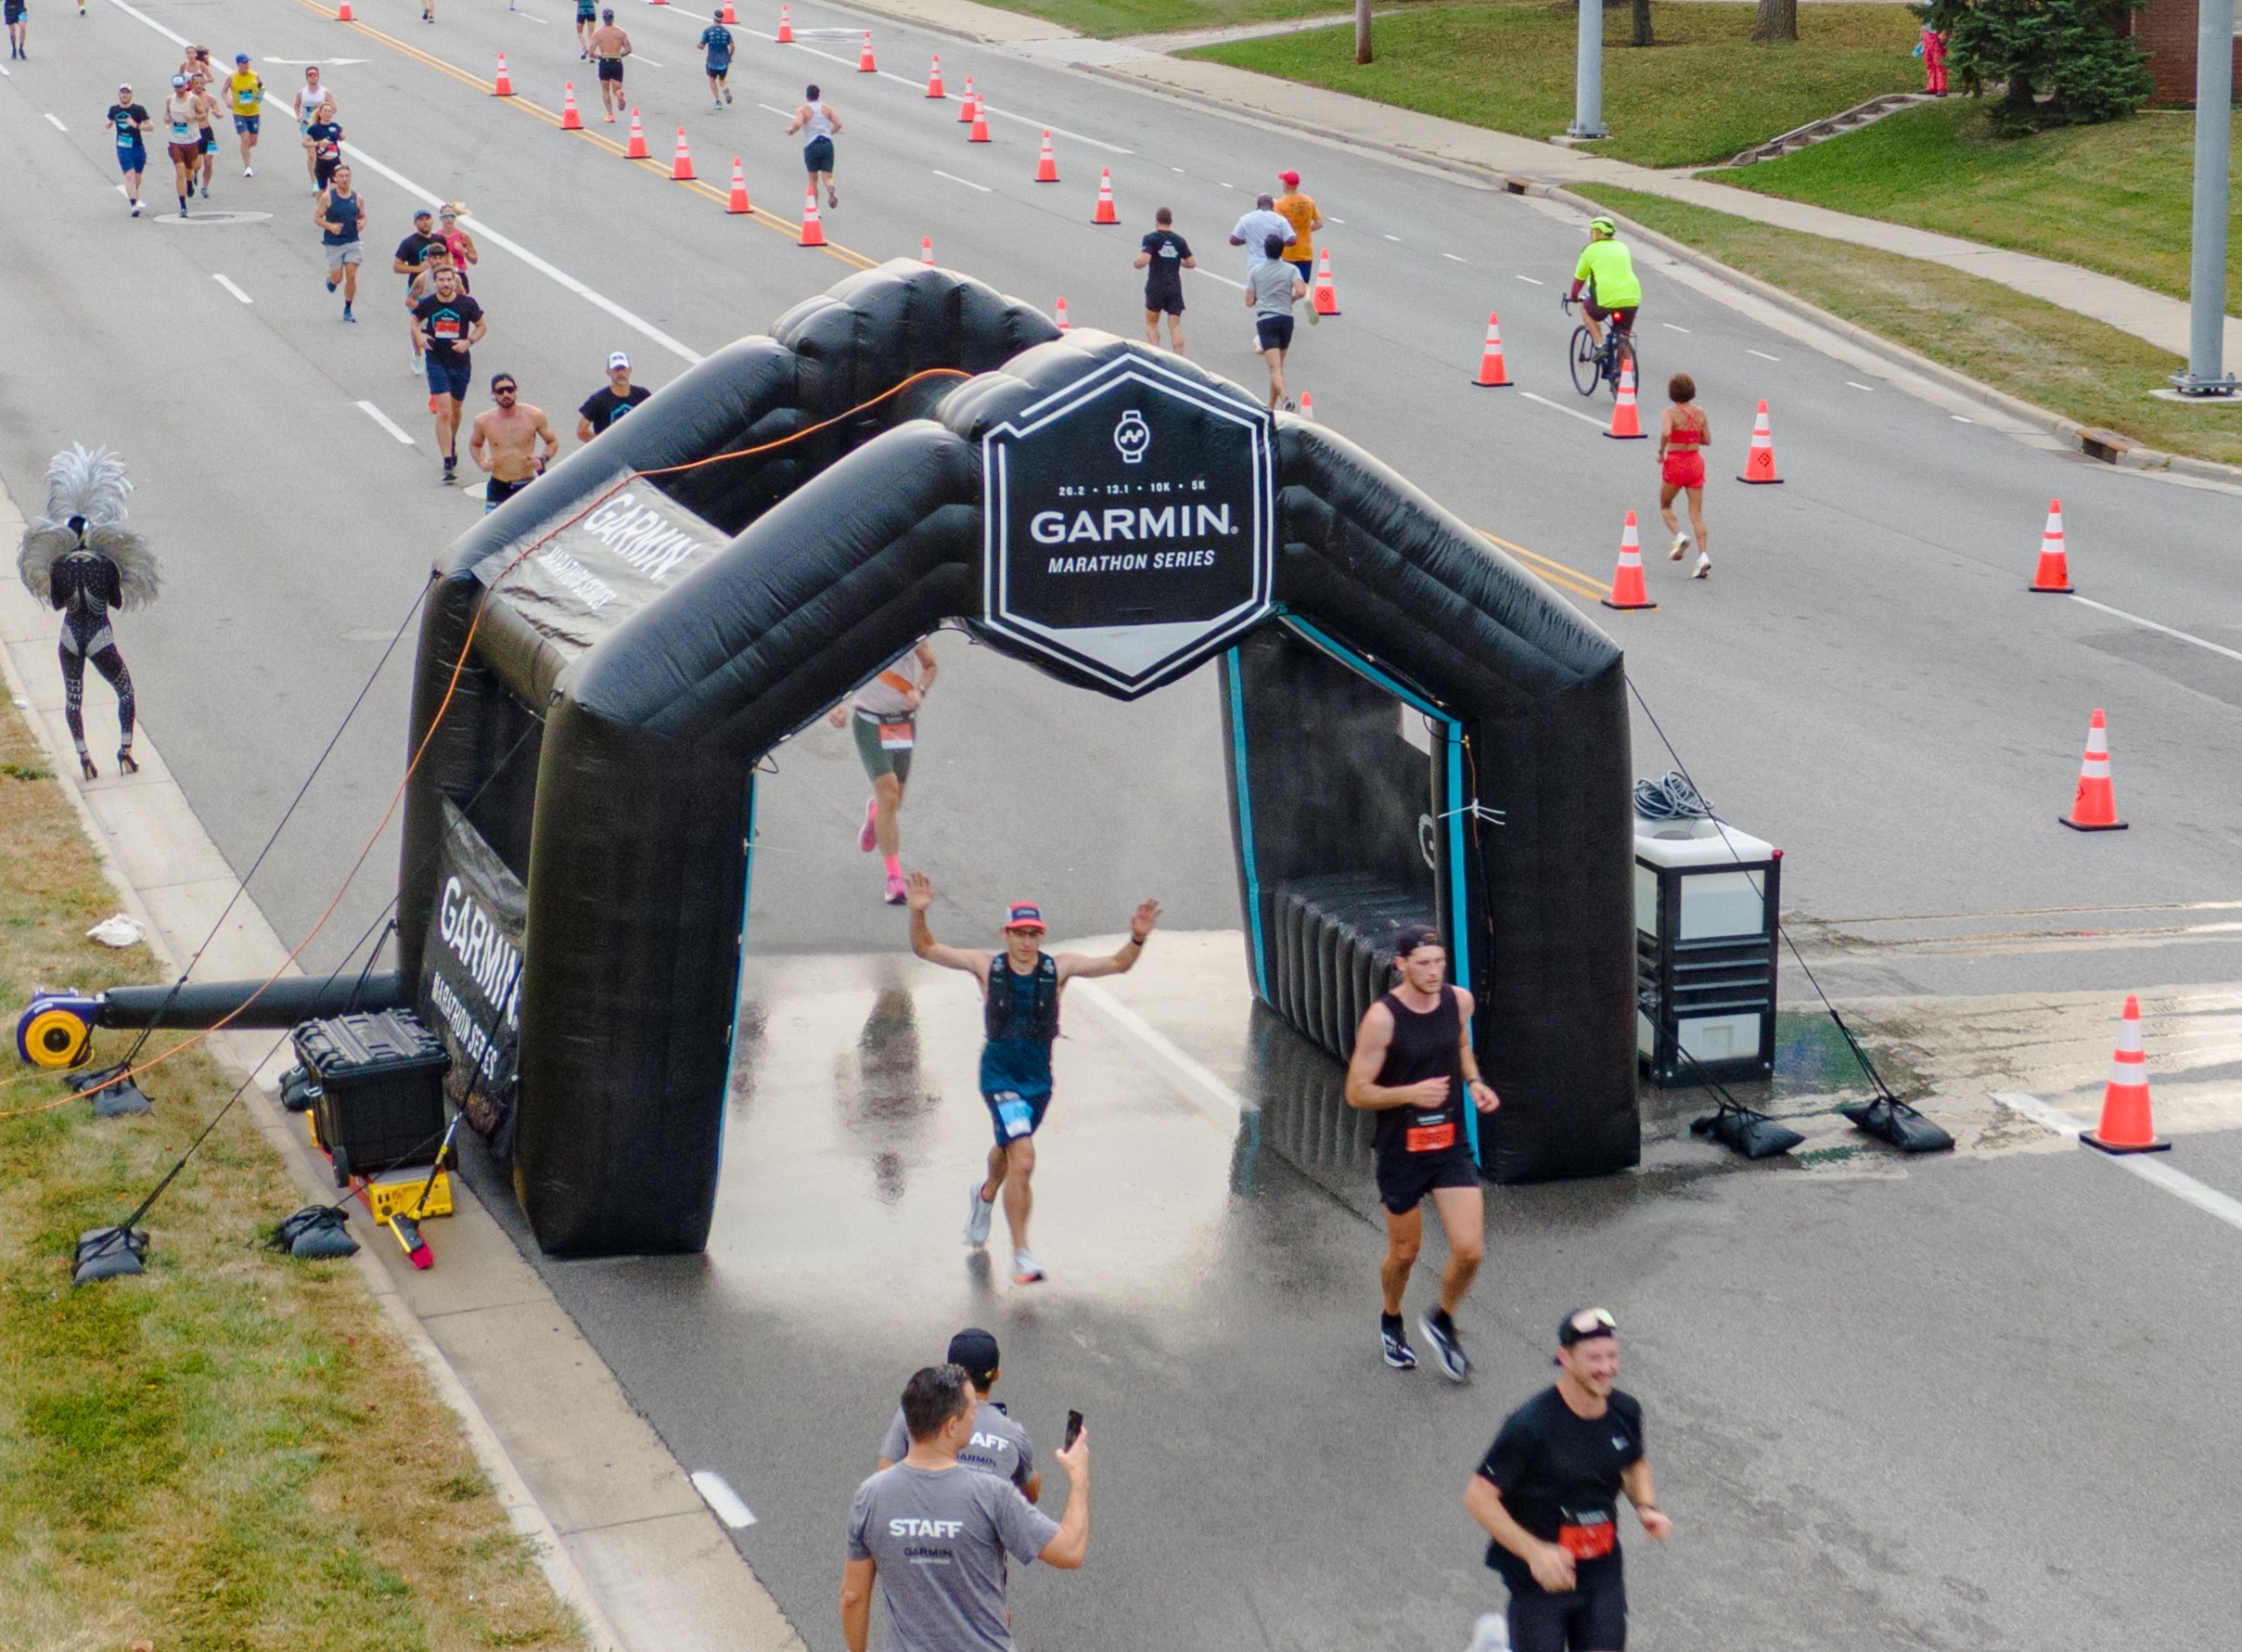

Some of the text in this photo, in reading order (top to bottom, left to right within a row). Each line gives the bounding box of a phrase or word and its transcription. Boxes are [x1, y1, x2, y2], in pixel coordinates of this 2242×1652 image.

[1058, 480, 1206, 496] 26.2 13.1 10K 5K
[1031, 503, 1230, 544] GARMIN
[583, 493, 701, 580] GARMIN
[1047, 549, 1216, 574] MARATHON SERIES
[440, 876, 523, 1026] GARMIN
[430, 971, 498, 1081] MARATHON SERES
[969, 1431, 1009, 1452] AFF
[956, 1453, 997, 1467] ARMIN
[889, 1518, 964, 1539] STAFF
[903, 1547, 953, 1558] GARMIN
